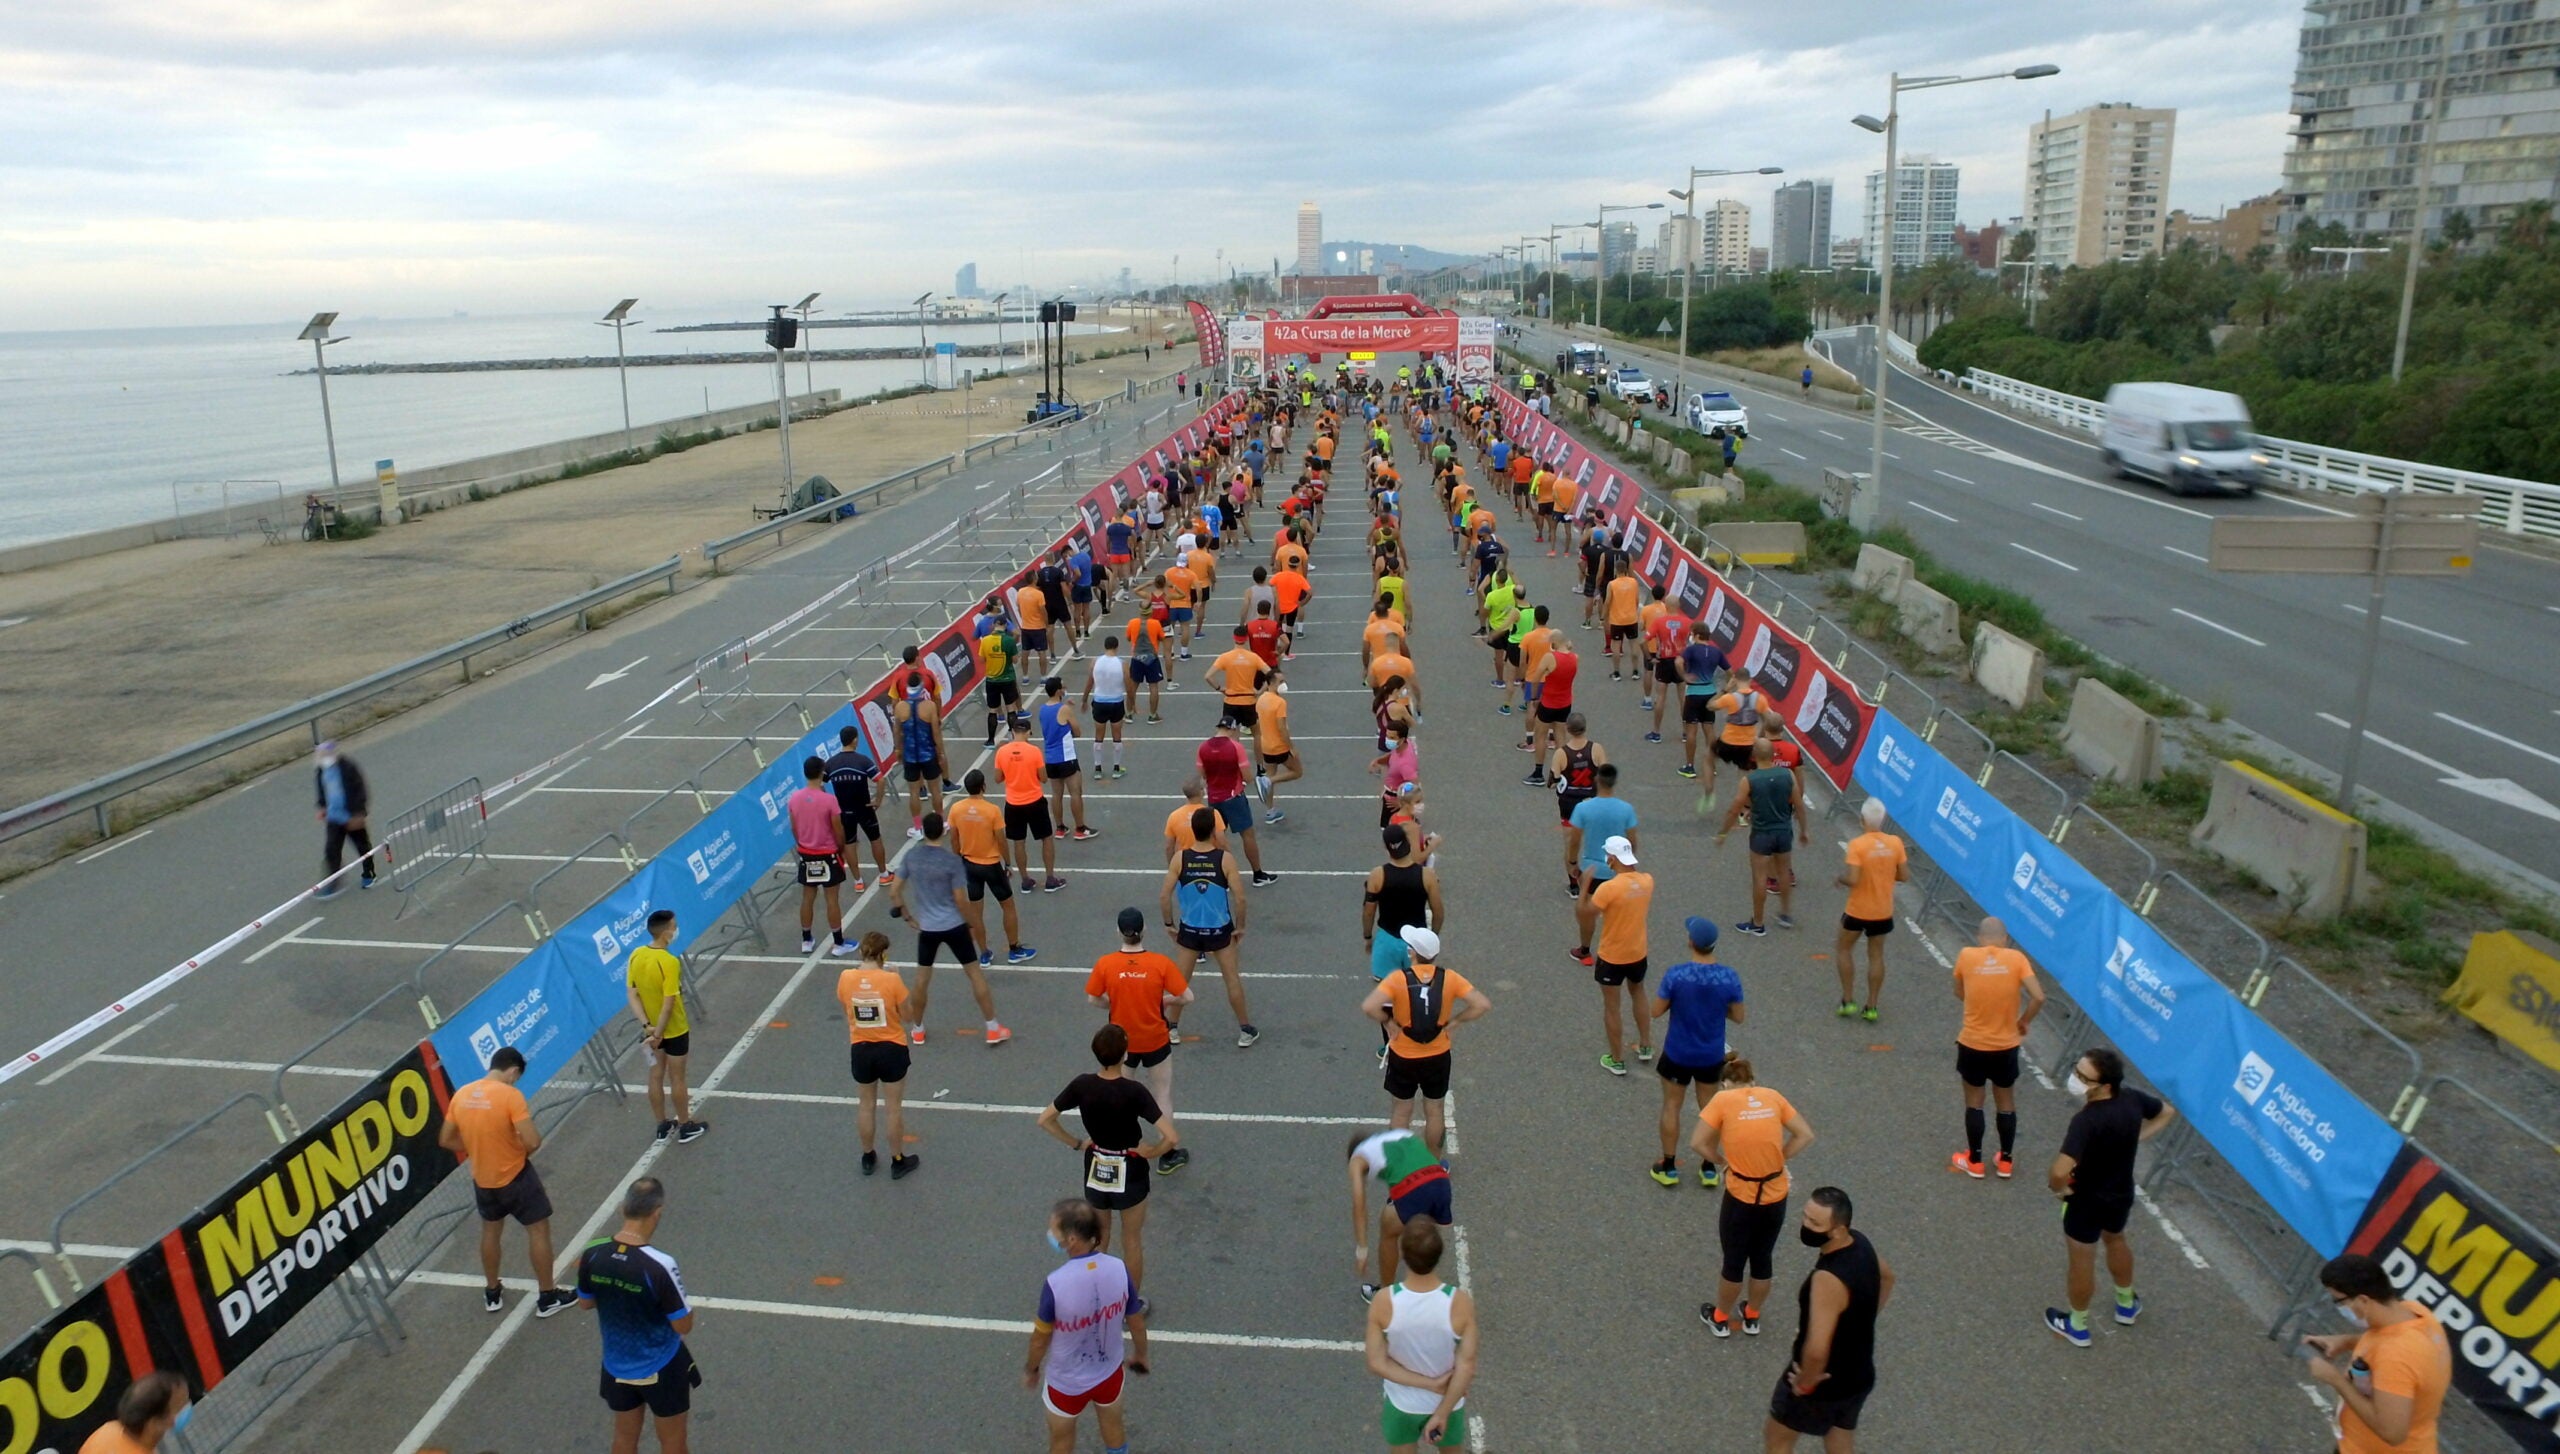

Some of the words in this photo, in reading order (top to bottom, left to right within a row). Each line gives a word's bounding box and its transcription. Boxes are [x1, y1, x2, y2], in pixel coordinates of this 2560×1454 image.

[1274, 326, 1298, 340] 42a
[1301, 326, 1338, 340] Cursa
[1340, 326, 1355, 340] de
[1358, 326, 1369, 339] la
[1372, 325, 1411, 339] Mercè
[496, 996, 528, 1031] Aigües
[527, 988, 543, 1003] de
[503, 1002, 549, 1047] Barcelona
[2262, 1099, 2326, 1164] Barcelona
[2273, 1082, 2318, 1127] Aigües
[2316, 1120, 2336, 1143] de
[198, 1069, 430, 1298] MUNDO
[218, 1154, 410, 1338] DEPORTIVO
